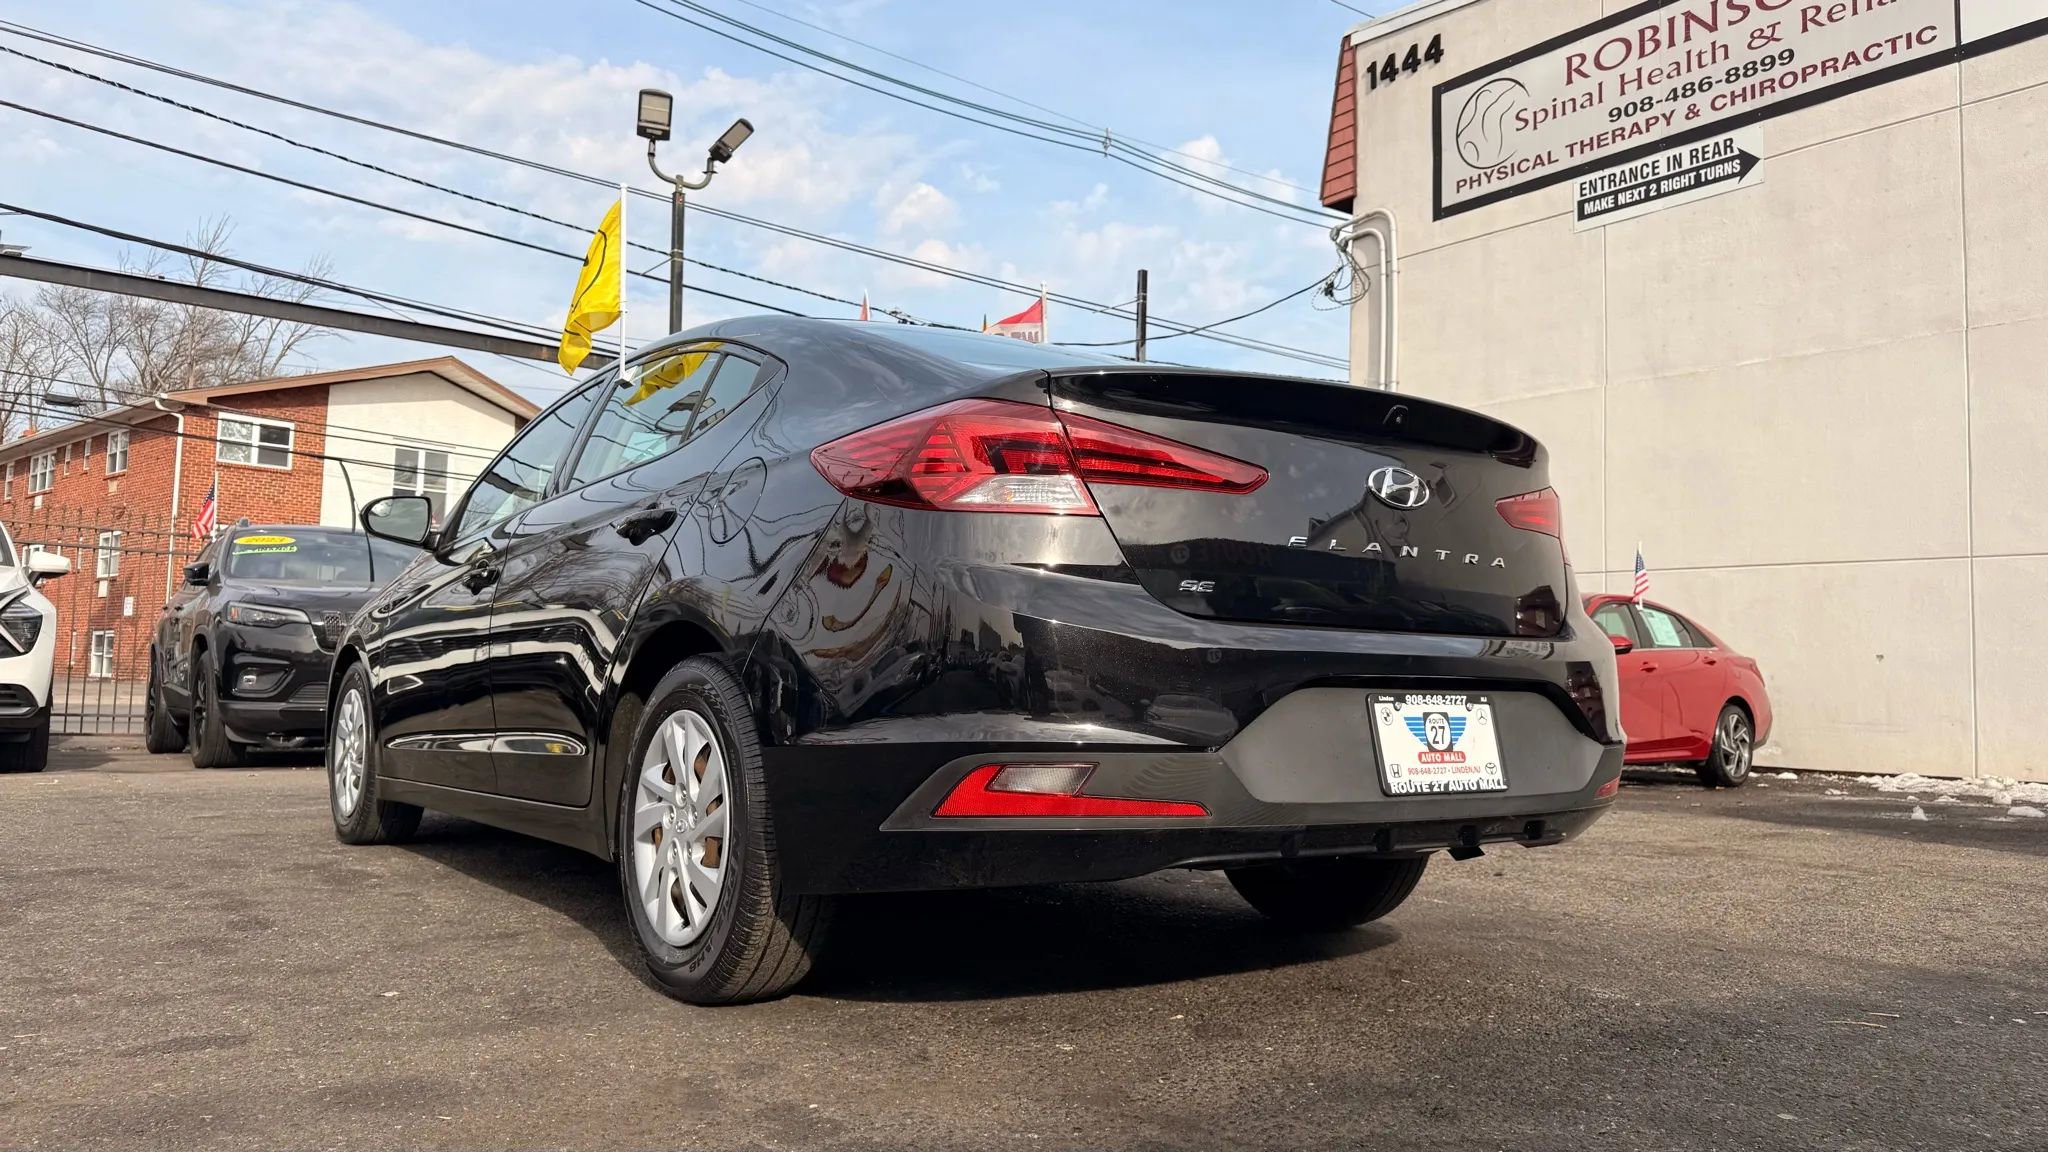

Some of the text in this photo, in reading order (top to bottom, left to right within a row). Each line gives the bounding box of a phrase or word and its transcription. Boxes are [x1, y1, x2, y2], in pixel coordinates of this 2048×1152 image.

[1366, 33, 1445, 90] 1444
[1515, 81, 1604, 132] Spinal
[1619, 40, 1730, 97] Health
[1747, 21, 1783, 50] &
[1608, 48, 1796, 123] 908-486-8899
[1456, 25, 1938, 193] PHYSICAL THERAPY & CHIROPRACTIC
[1579, 137, 1735, 198] ENTRANCE IN REAR
[1583, 159, 1741, 215] MAKE NEXT 2 RIGHT TURNS
[1287, 535, 1507, 569] ELANTRA
[1178, 579, 1216, 593] SE
[1405, 694, 1467, 705] 908-648-2727
[1420, 752, 1465, 762] AUTO MALL
[1430, 726, 1446, 745] 27
[1390, 779, 1508, 793] ROUTE 27 AUTO MALL
